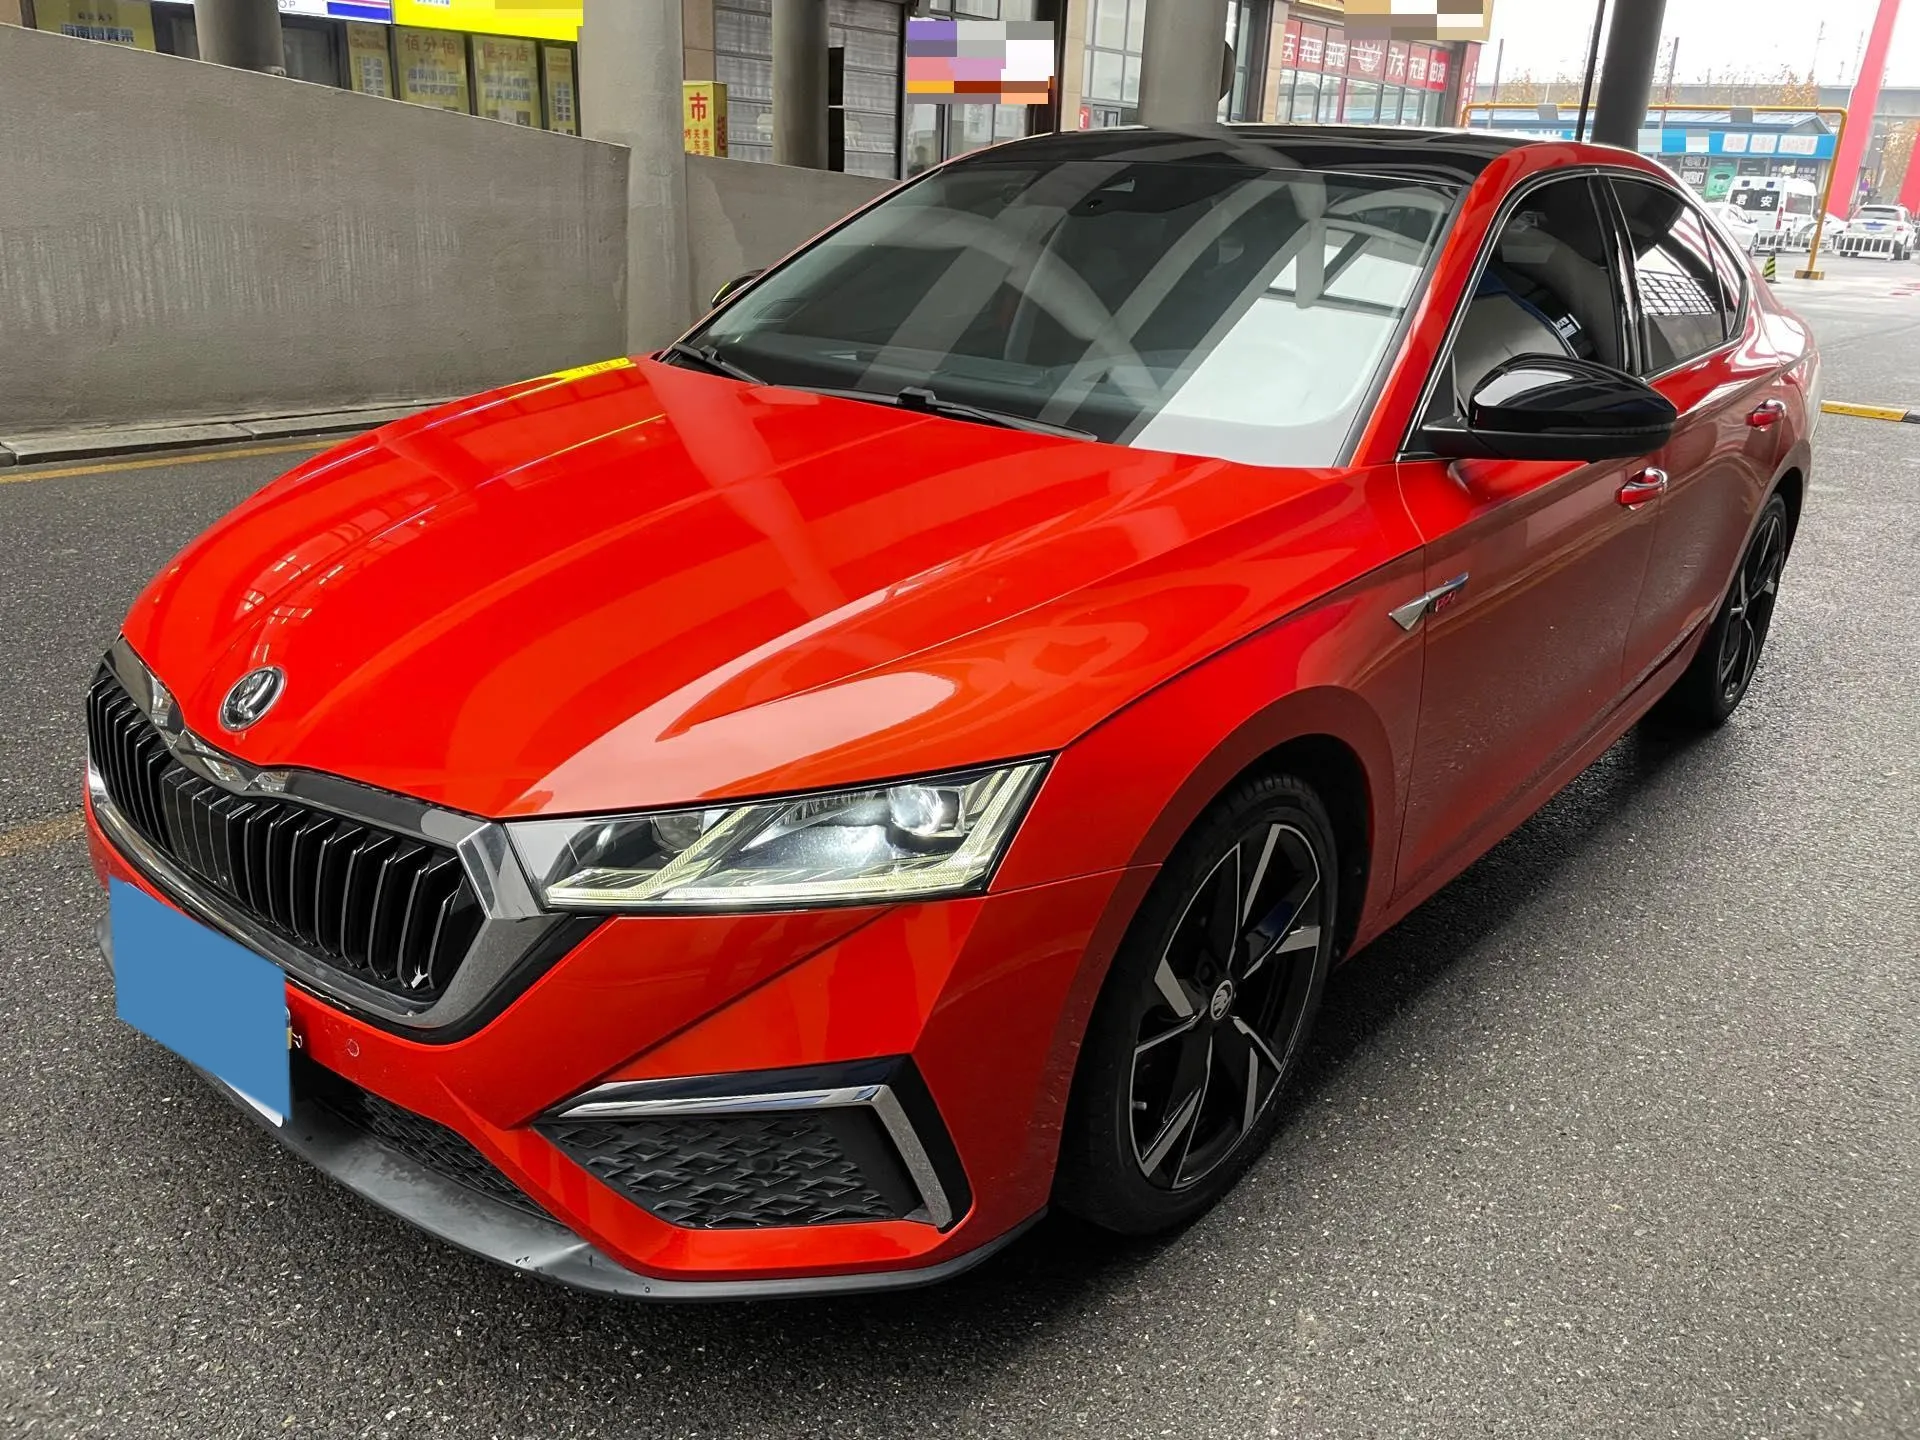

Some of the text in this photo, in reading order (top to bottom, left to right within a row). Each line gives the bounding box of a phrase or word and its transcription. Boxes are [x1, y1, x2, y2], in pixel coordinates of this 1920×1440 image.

[404, 33, 456, 56] 佰分佰
[689, 92, 708, 122] 市
